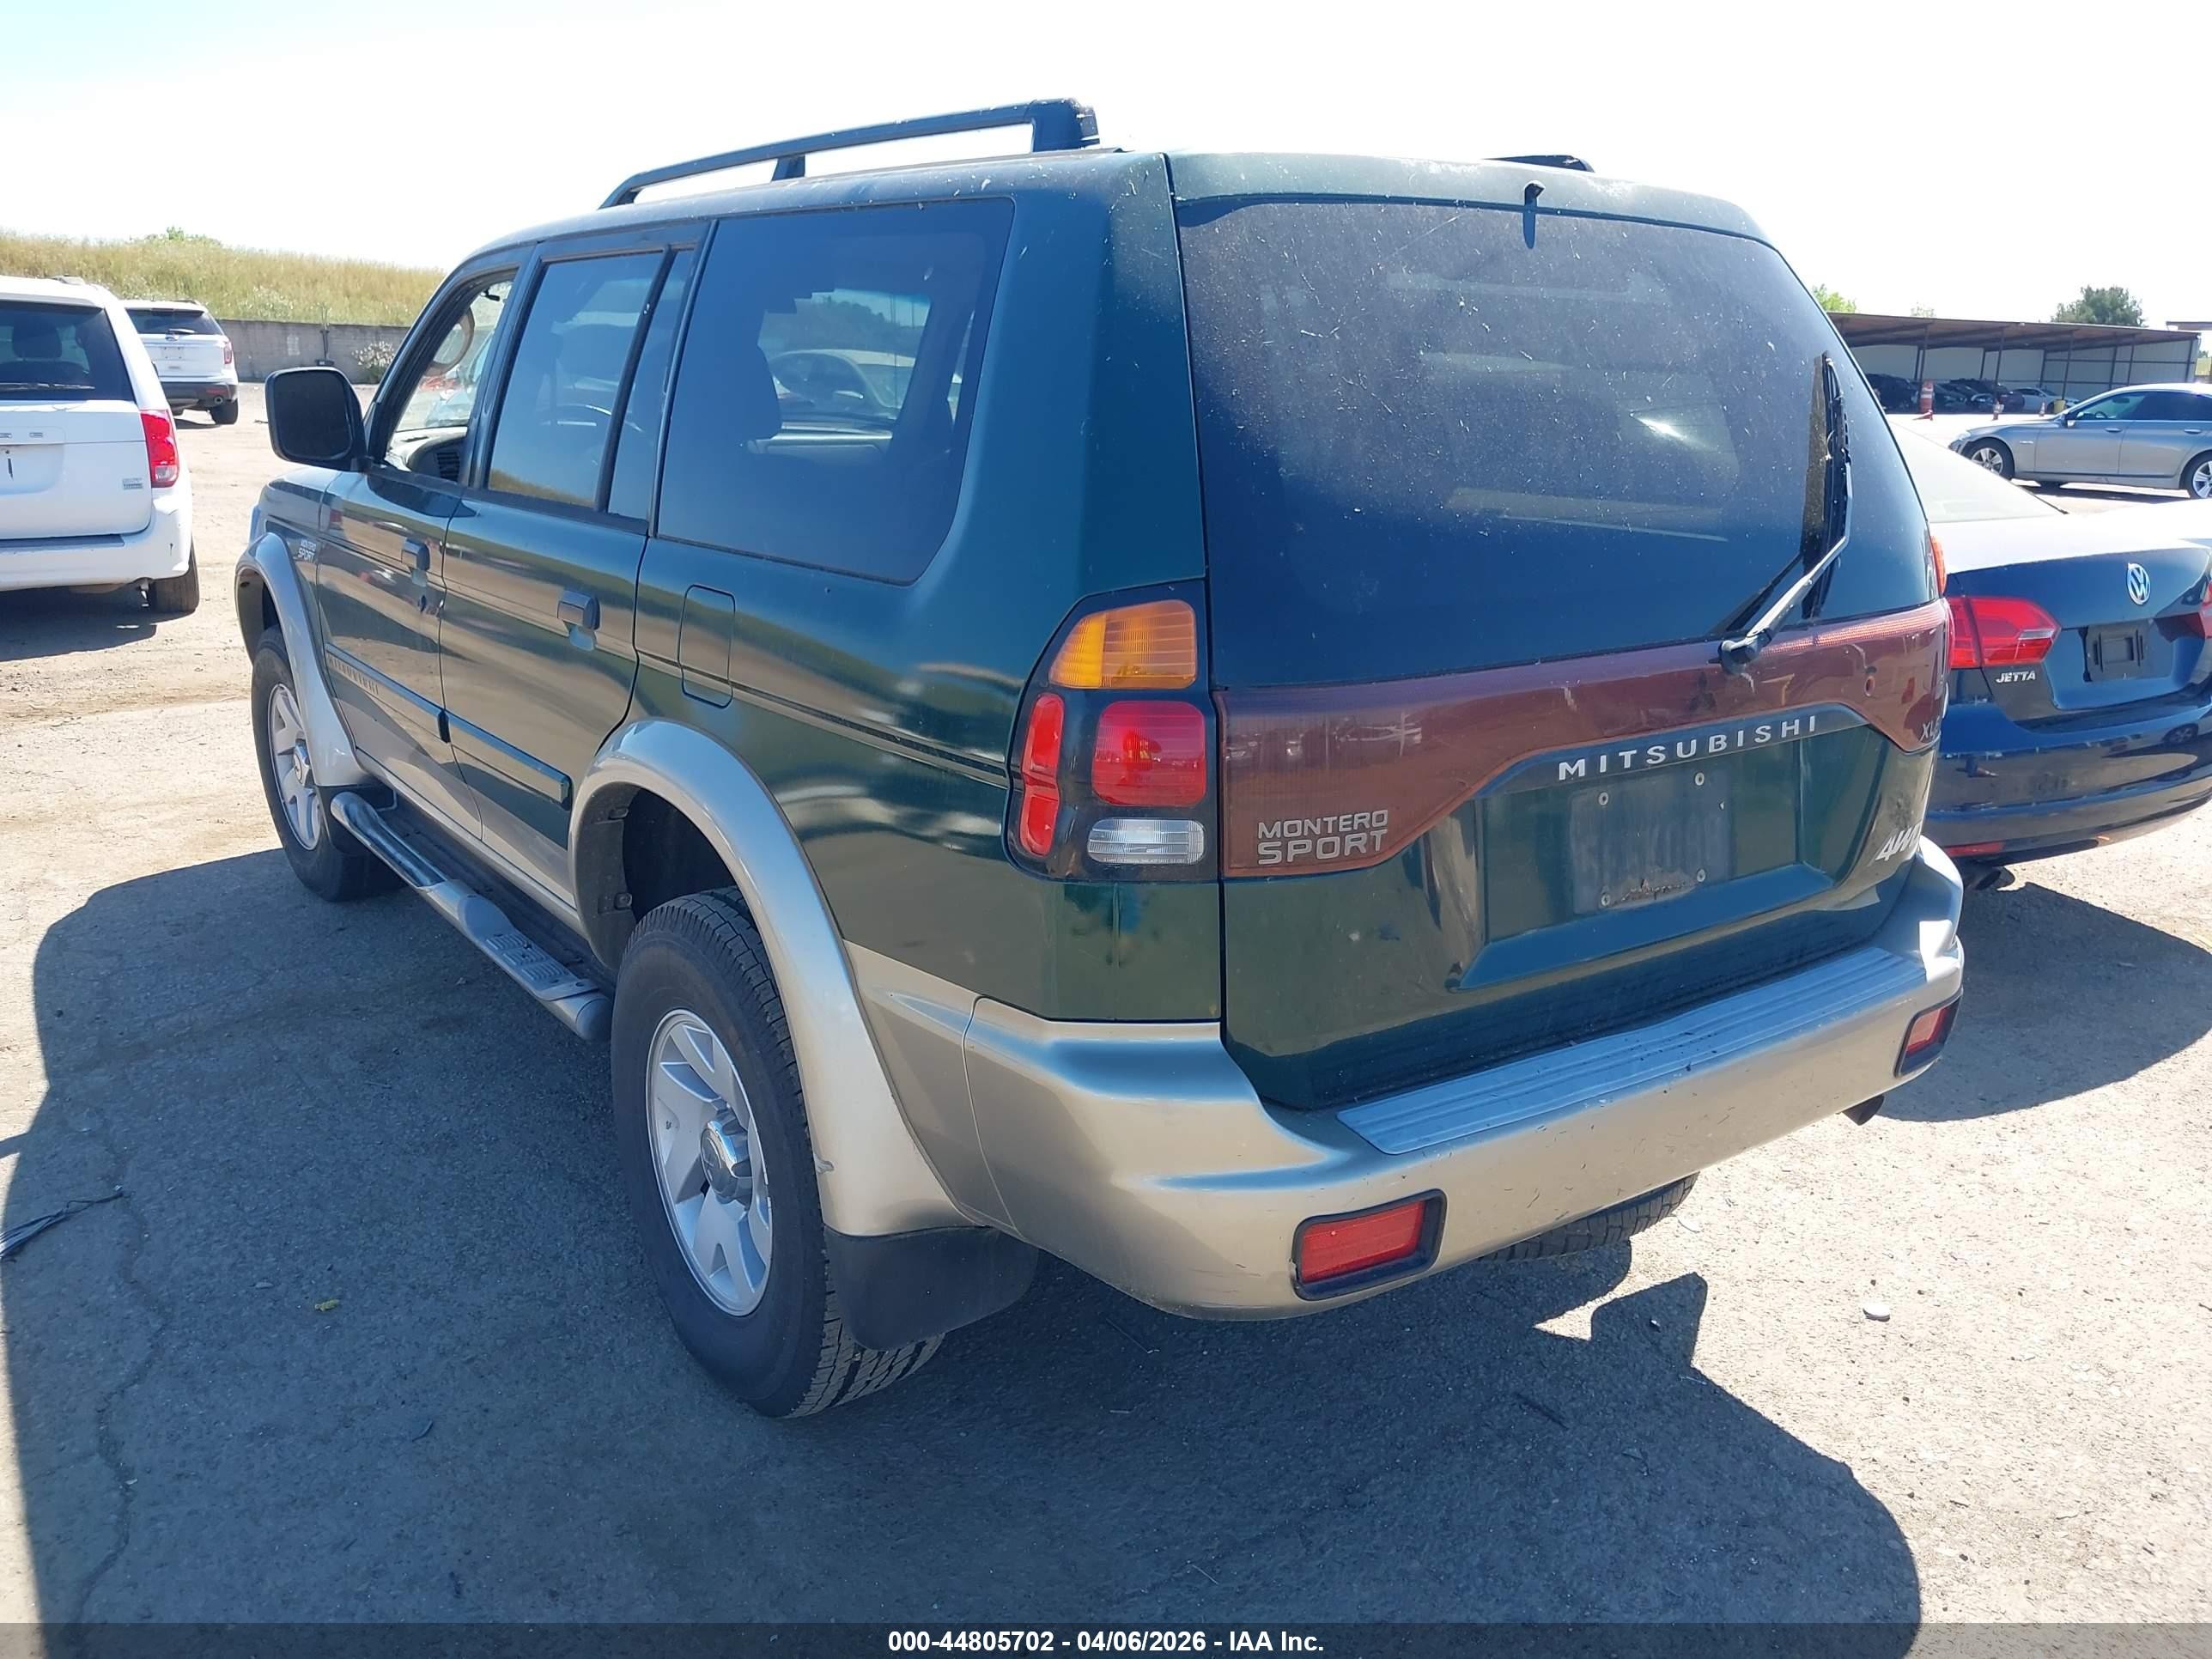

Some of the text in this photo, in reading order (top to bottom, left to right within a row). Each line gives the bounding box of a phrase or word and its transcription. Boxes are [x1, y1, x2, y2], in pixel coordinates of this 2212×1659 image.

[1996, 670, 2037, 684] JETTA
[1559, 714, 1816, 781] MITSUBISHI
[1257, 809, 1389, 839] MONTERO
[1257, 829, 1389, 865] SPORT
